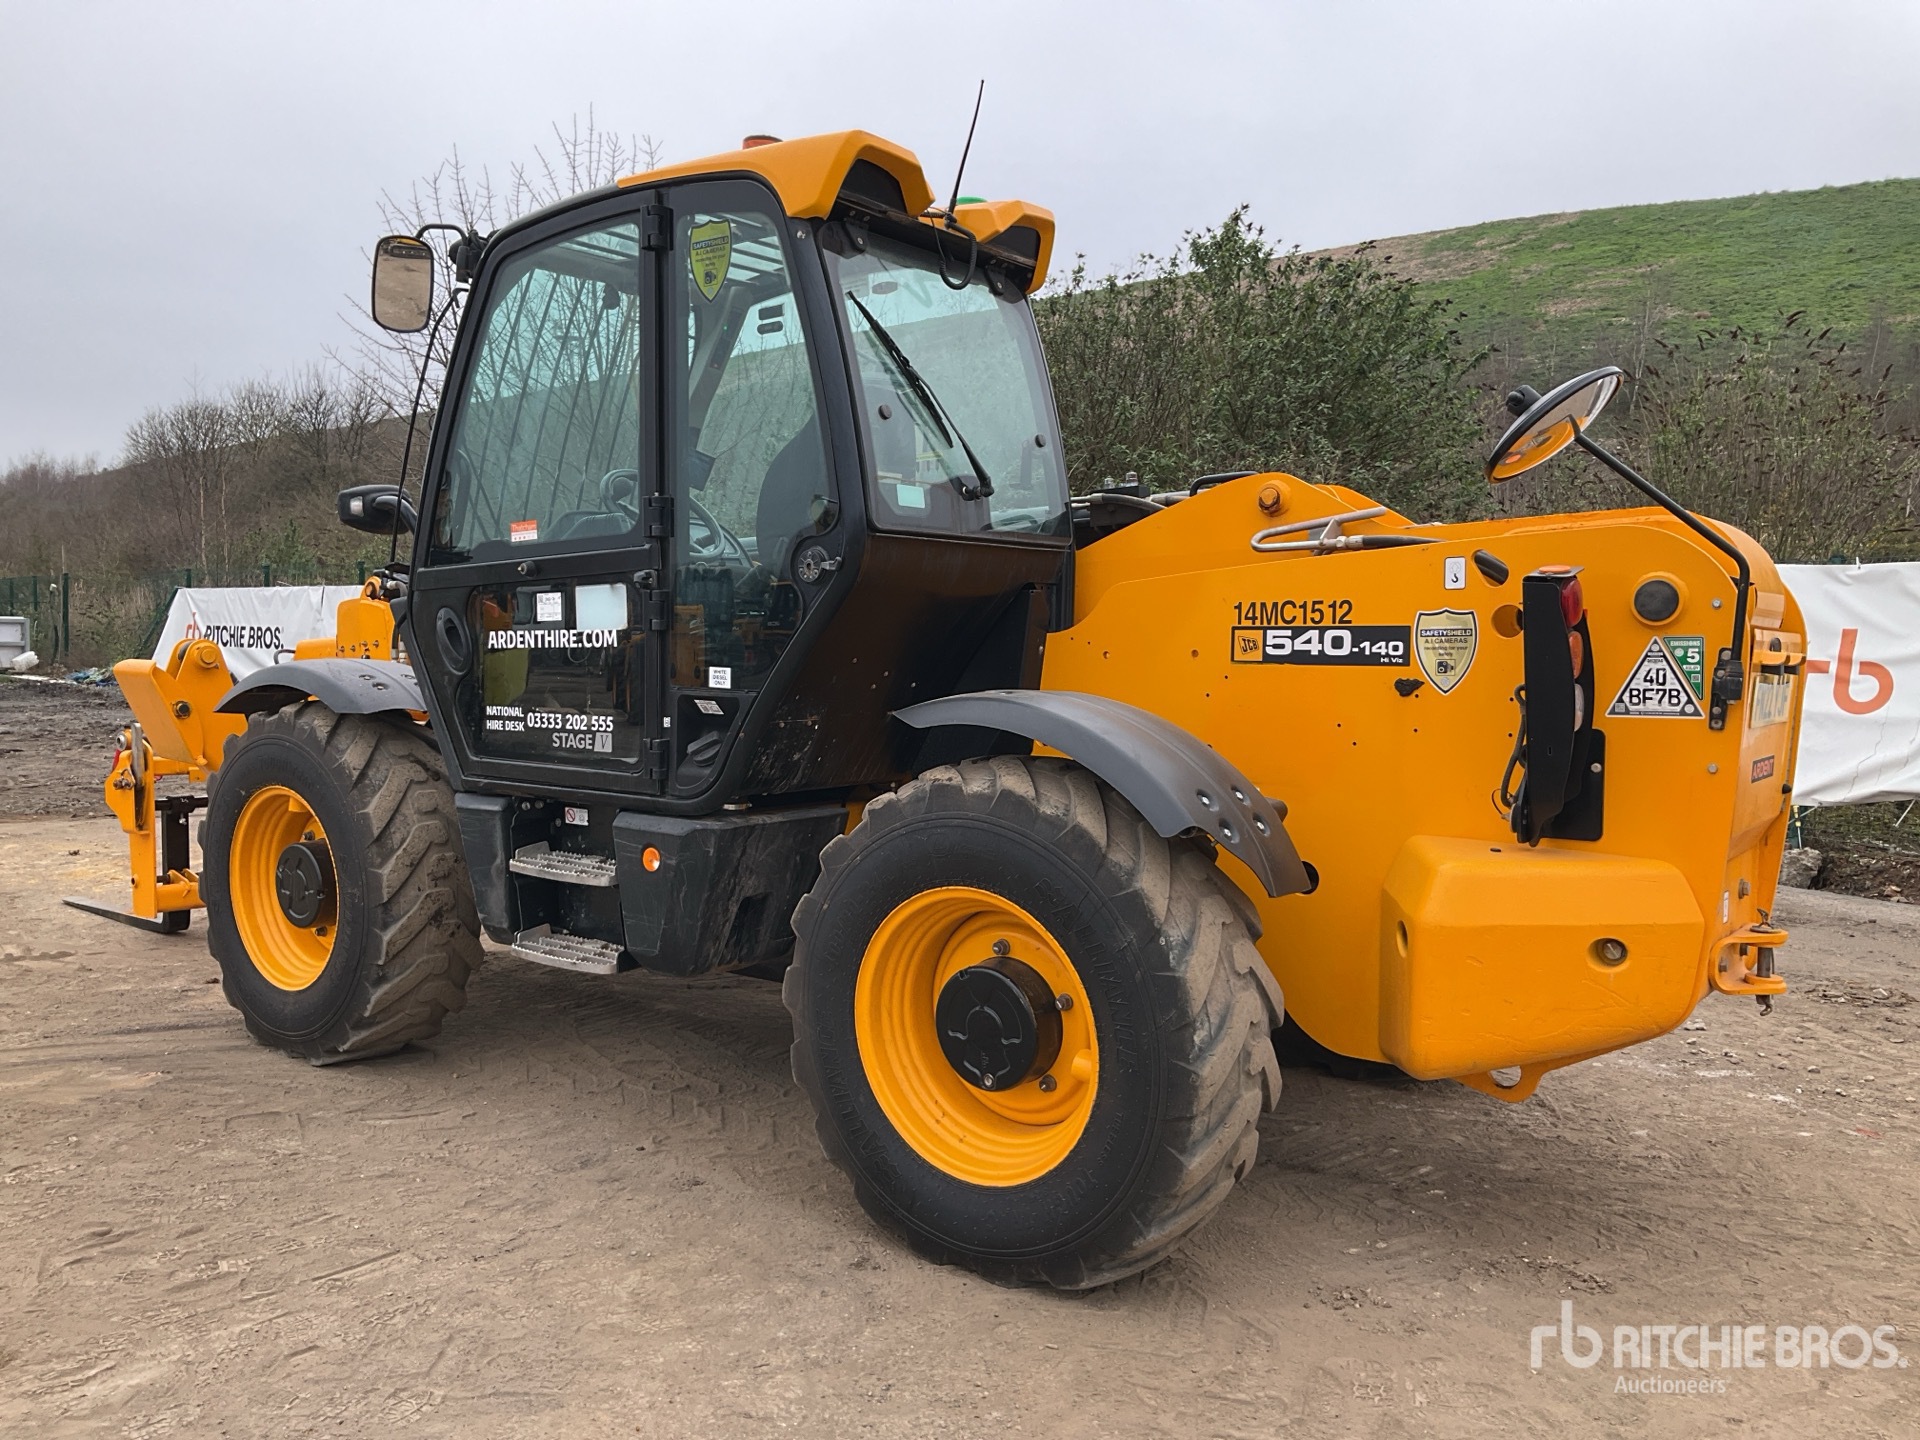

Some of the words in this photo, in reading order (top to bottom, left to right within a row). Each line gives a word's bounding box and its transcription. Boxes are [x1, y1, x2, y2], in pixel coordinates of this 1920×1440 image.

[204, 625, 246, 647] RITCHIE
[488, 629, 618, 649] ARDENTHIRE.COM
[1241, 637, 1259, 653] JCB
[1686, 648, 1700, 663] 5
[1629, 688, 1681, 706] BF7B
[486, 706, 524, 717] NATIONAL
[486, 720, 504, 731] HIRE
[505, 721, 525, 731] DESK
[527, 712, 562, 729] 03333
[565, 714, 588, 730] 202
[591, 716, 614, 731] 555
[552, 733, 593, 749] STAGE
